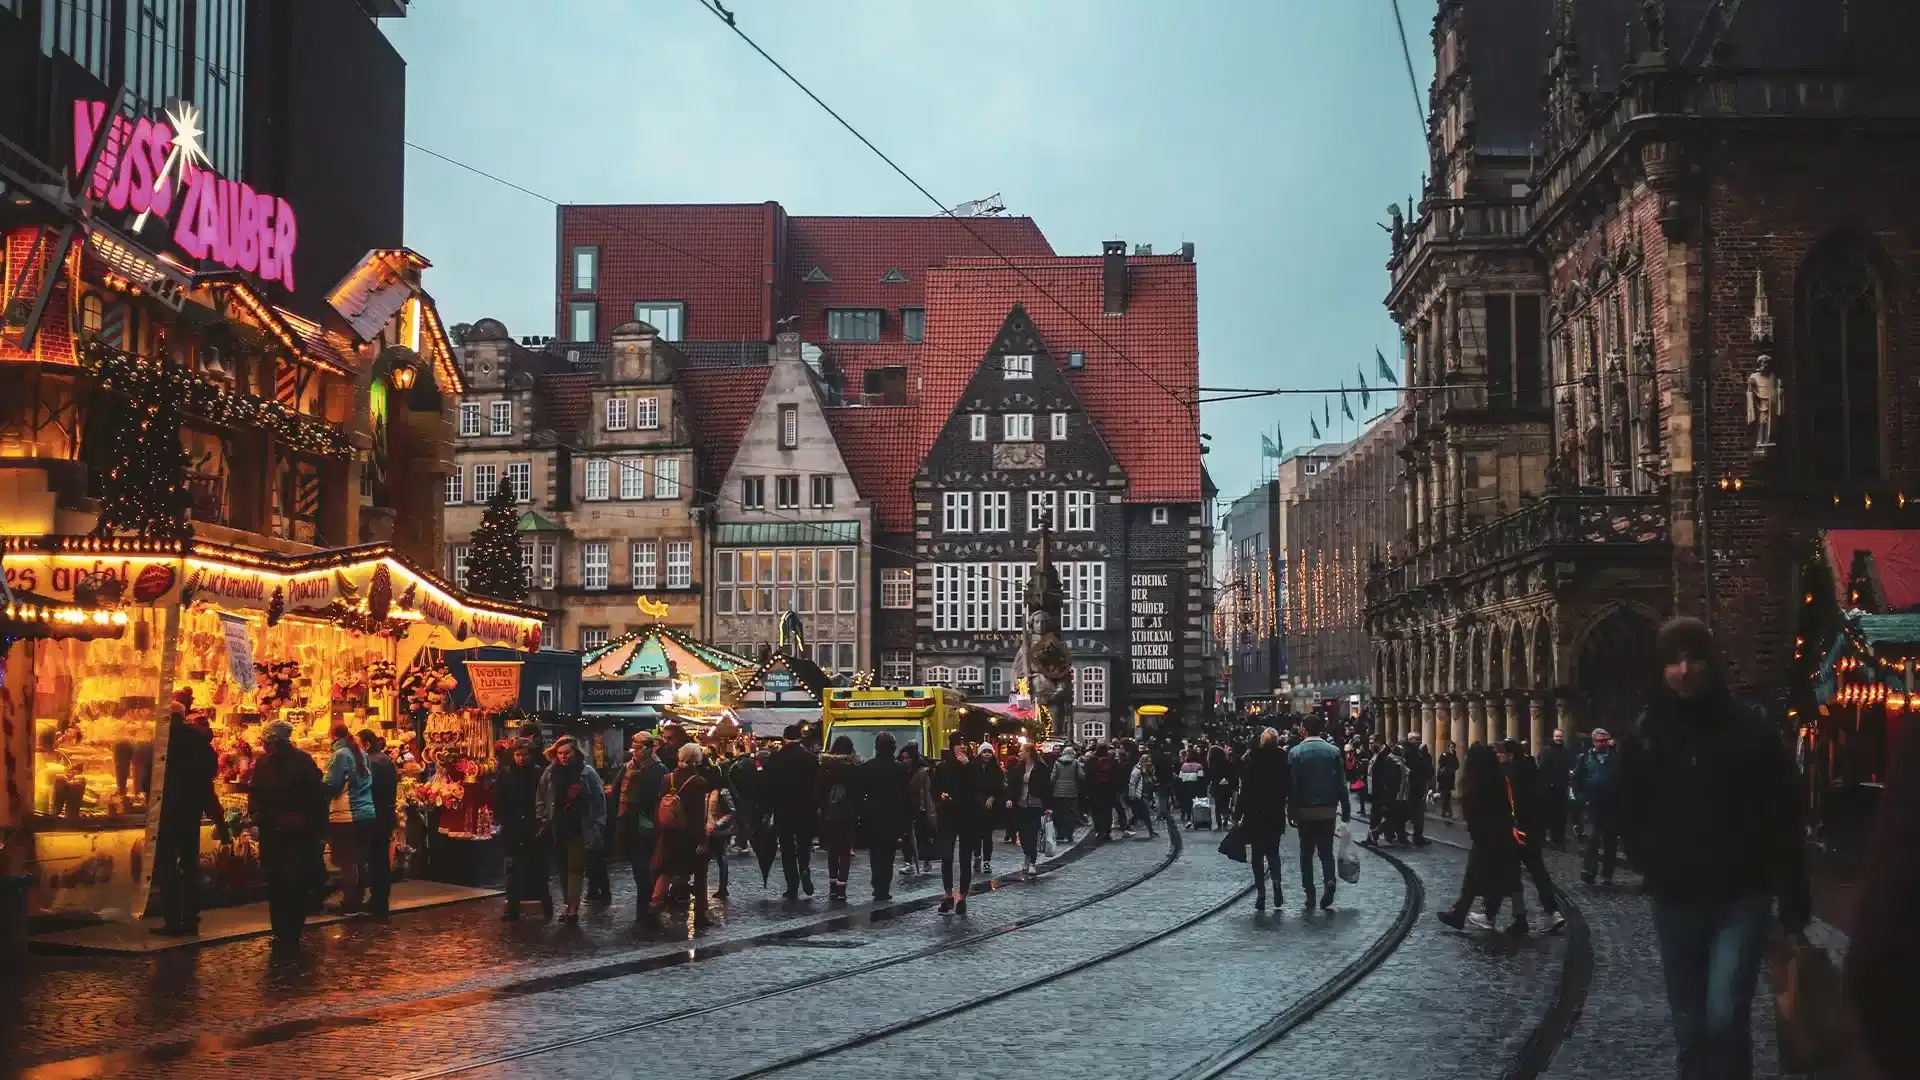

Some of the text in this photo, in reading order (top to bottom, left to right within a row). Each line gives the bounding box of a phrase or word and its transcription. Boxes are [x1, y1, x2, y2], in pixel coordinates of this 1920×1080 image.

[173, 158, 297, 293] ZAUBER
[1131, 574, 1168, 587] GEDENKE
[287, 577, 330, 604] Popcorn
[1131, 588, 1148, 601] DER
[1131, 616, 1162, 629] DIE AS
[1131, 630, 1174, 643] SCHICKSAL
[1131, 644, 1168, 657] UNSERER
[1131, 658, 1174, 671] TRENNUNG
[475, 667, 513, 678] Waffel
[587, 687, 633, 697] Souvenirs
